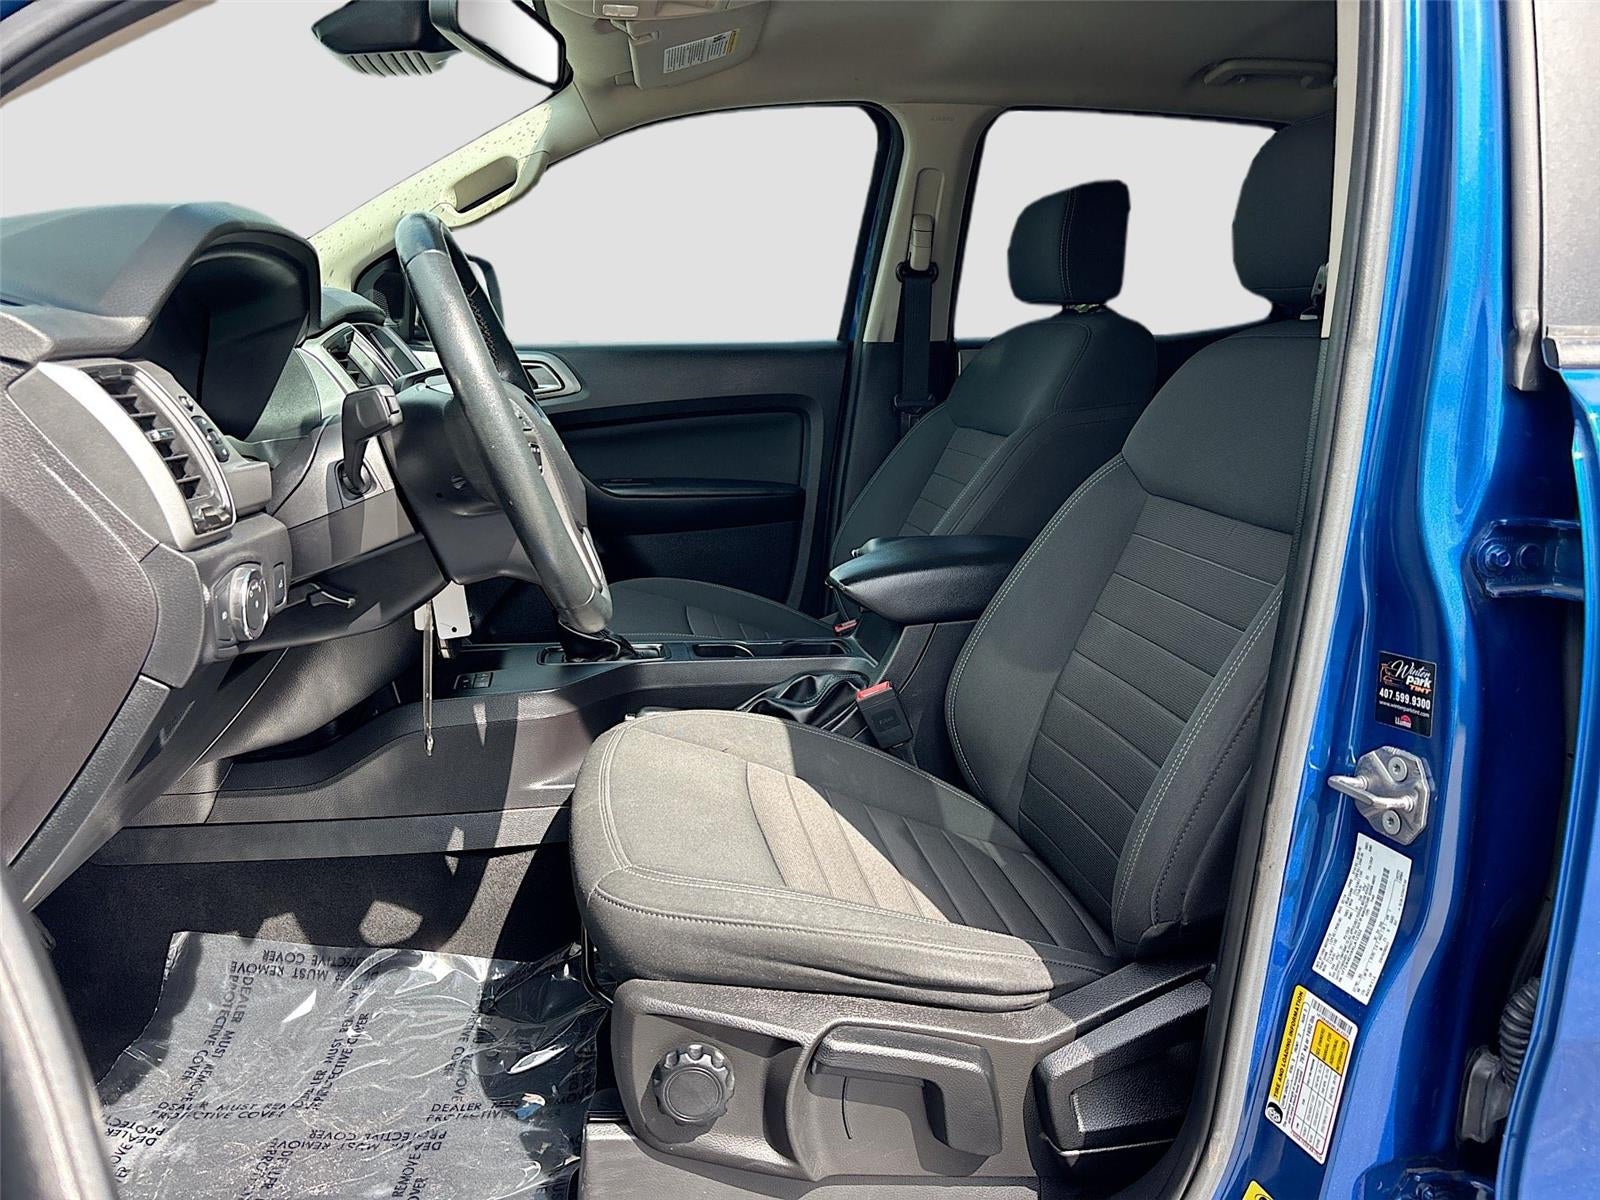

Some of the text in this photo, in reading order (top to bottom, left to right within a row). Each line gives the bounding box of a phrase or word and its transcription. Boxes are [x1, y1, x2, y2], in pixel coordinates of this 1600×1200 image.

[1391, 660, 1431, 679] Winter
[1379, 687, 1431, 710] 407.599.9300
[262, 950, 305, 964] COVER
[230, 961, 285, 978] REMOVE
[292, 967, 329, 982] MUST
[231, 976, 254, 1024] DEALER
[212, 1030, 235, 1059] MUST
[1273, 1082, 1281, 1098] TIRE
[1277, 1067, 1285, 1083] AND
[1281, 1038, 1292, 1068] LOADING
[1289, 990, 1303, 1037] INFORMATION
[181, 1049, 209, 1081] COVER
[158, 1101, 209, 1112] DEALR
[215, 1102, 257, 1112] MUST
[431, 1102, 482, 1113] DEALER
[105, 1127, 158, 1147] DEALER
[269, 1137, 331, 1151] REMOVE
[309, 1128, 448, 1142] PROECTIVE COVER
[391, 1153, 422, 1198] REMOVE
